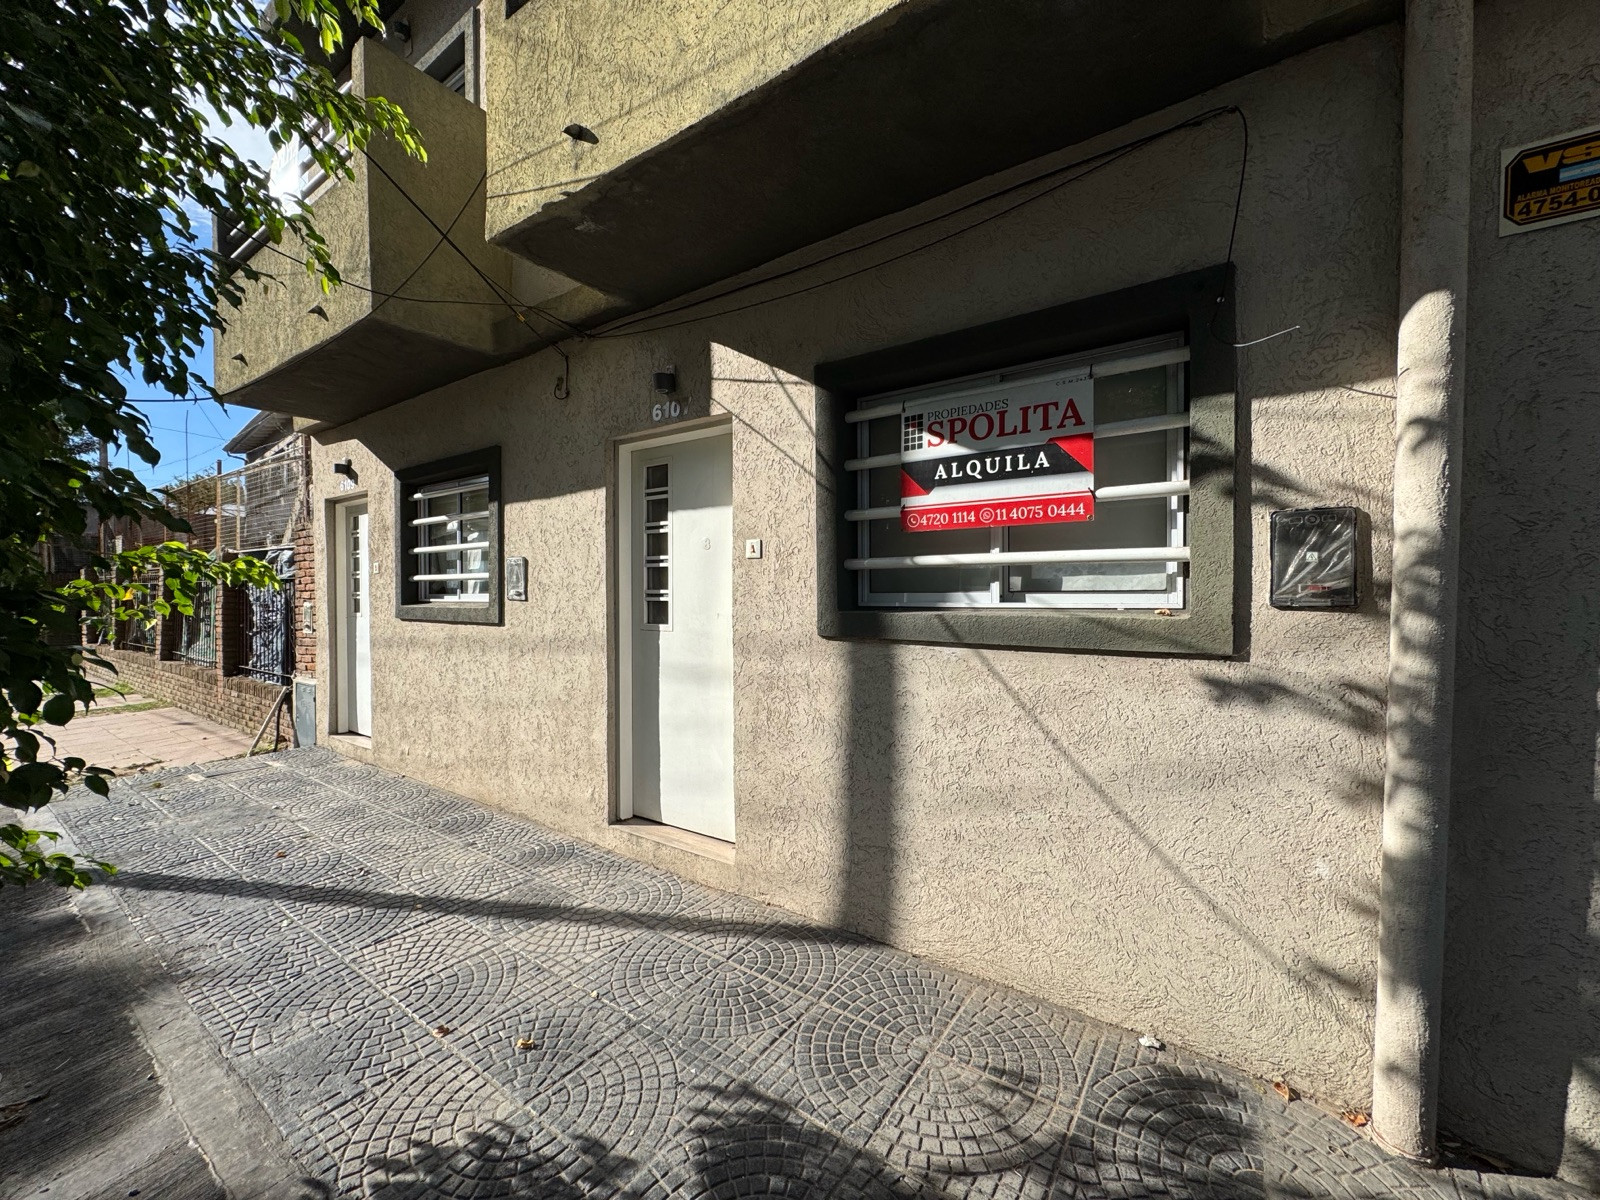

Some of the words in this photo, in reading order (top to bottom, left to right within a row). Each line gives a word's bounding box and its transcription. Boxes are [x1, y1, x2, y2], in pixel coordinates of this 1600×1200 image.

[1517, 189, 1547, 201] ALARMA
[927, 398, 1009, 422] PROPIEDADES
[927, 398, 1085, 448] SPOLITA
[934, 451, 1050, 480] ALQUILA
[920, 513, 948, 526] 4720
[952, 511, 976, 524] 1114
[1009, 505, 1043, 519] 4075
[1047, 502, 1085, 517] 0444
